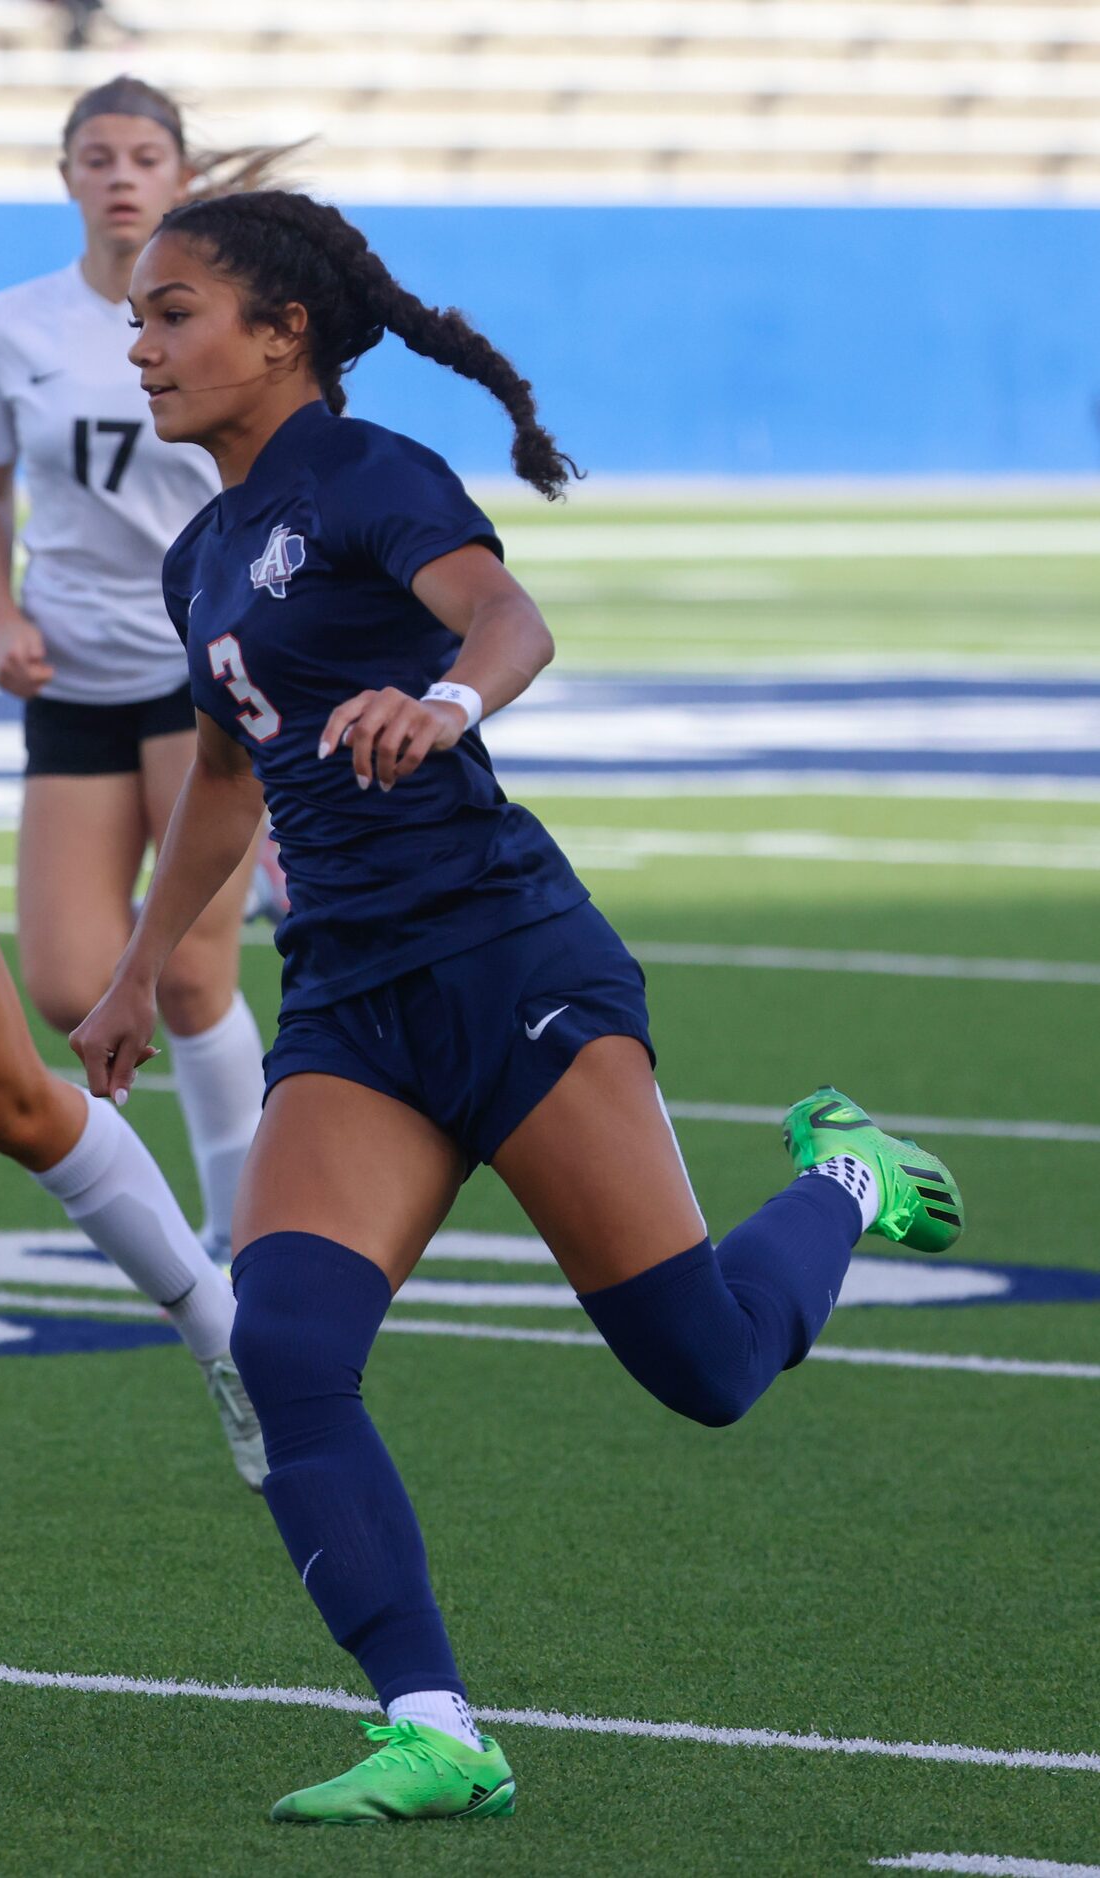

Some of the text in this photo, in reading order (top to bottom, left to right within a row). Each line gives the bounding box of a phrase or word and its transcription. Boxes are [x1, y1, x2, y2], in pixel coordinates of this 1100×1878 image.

[73, 419, 144, 493] 17
[253, 524, 293, 589] A
[207, 632, 283, 744] 3
